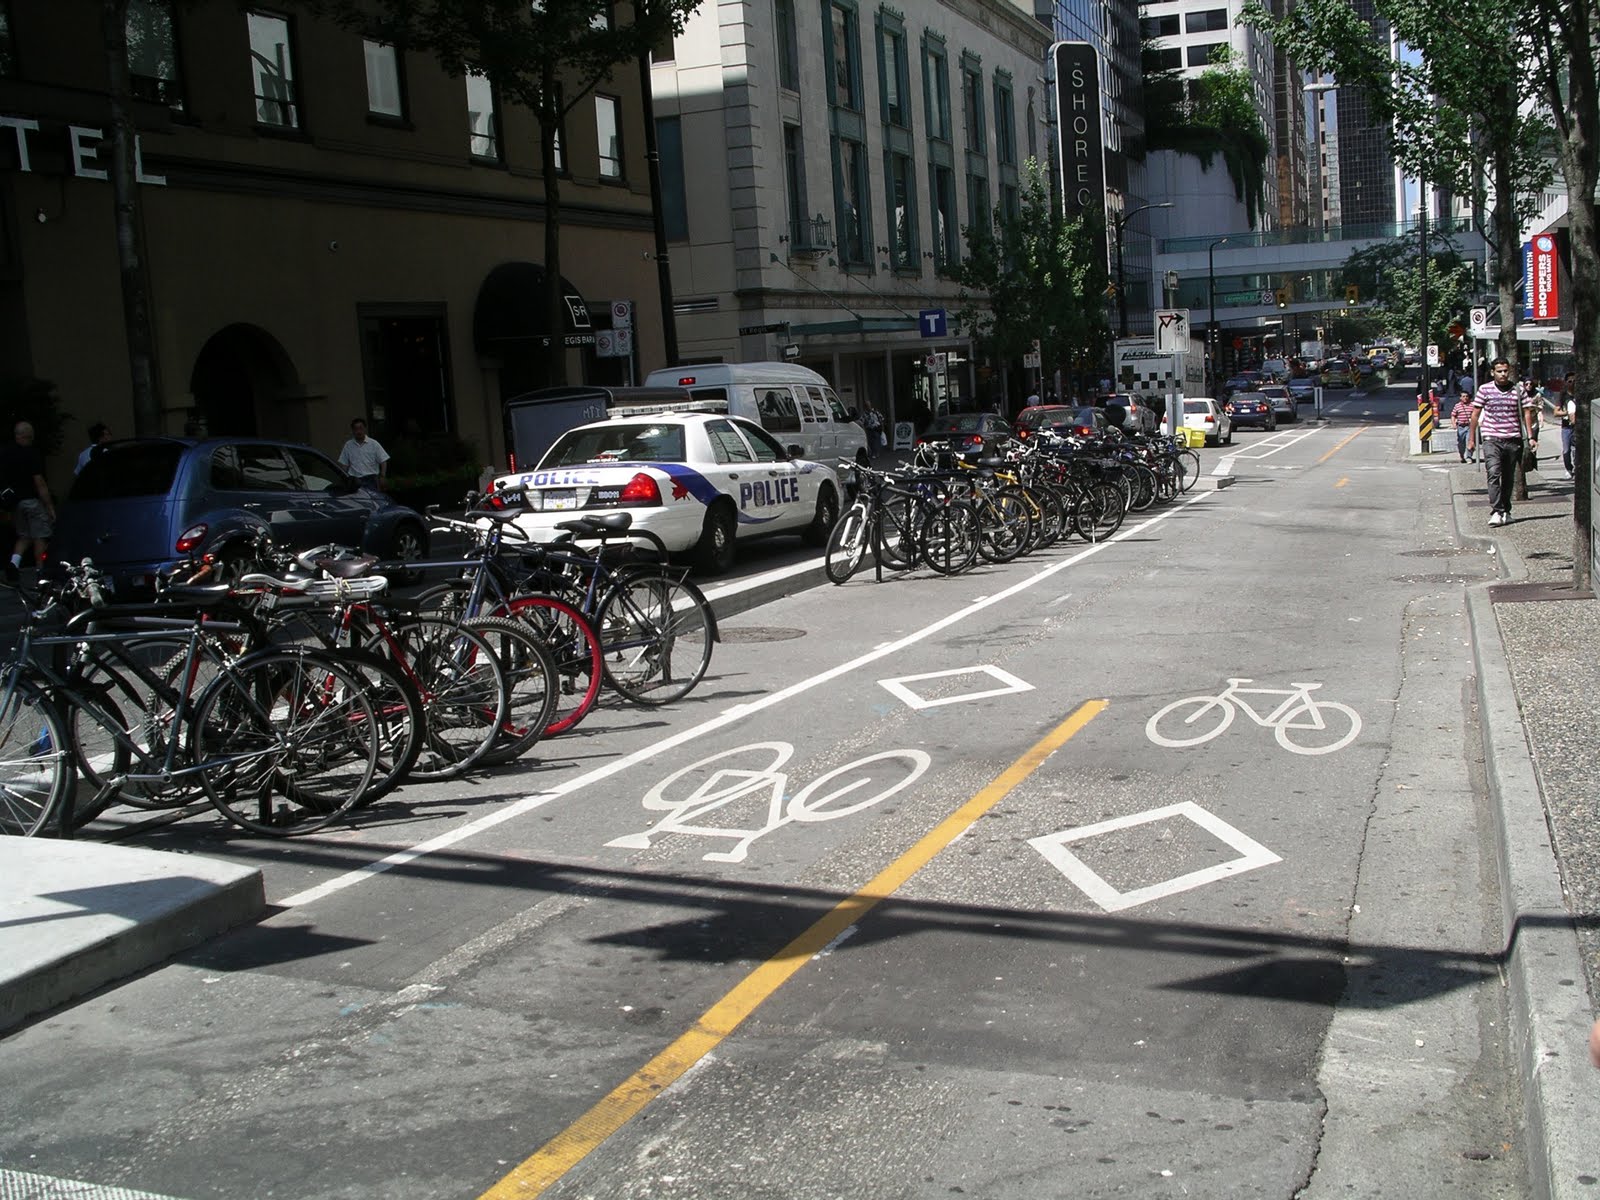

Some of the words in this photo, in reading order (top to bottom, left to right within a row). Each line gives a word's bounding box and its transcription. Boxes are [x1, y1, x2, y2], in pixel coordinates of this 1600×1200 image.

[0, 116, 167, 186] TEL
[1538, 254, 1547, 317] SHOPPERS
[925, 314, 940, 333] T
[564, 336, 582, 345] EGIS
[519, 471, 601, 487] POLICE
[739, 477, 800, 508] POLICE
